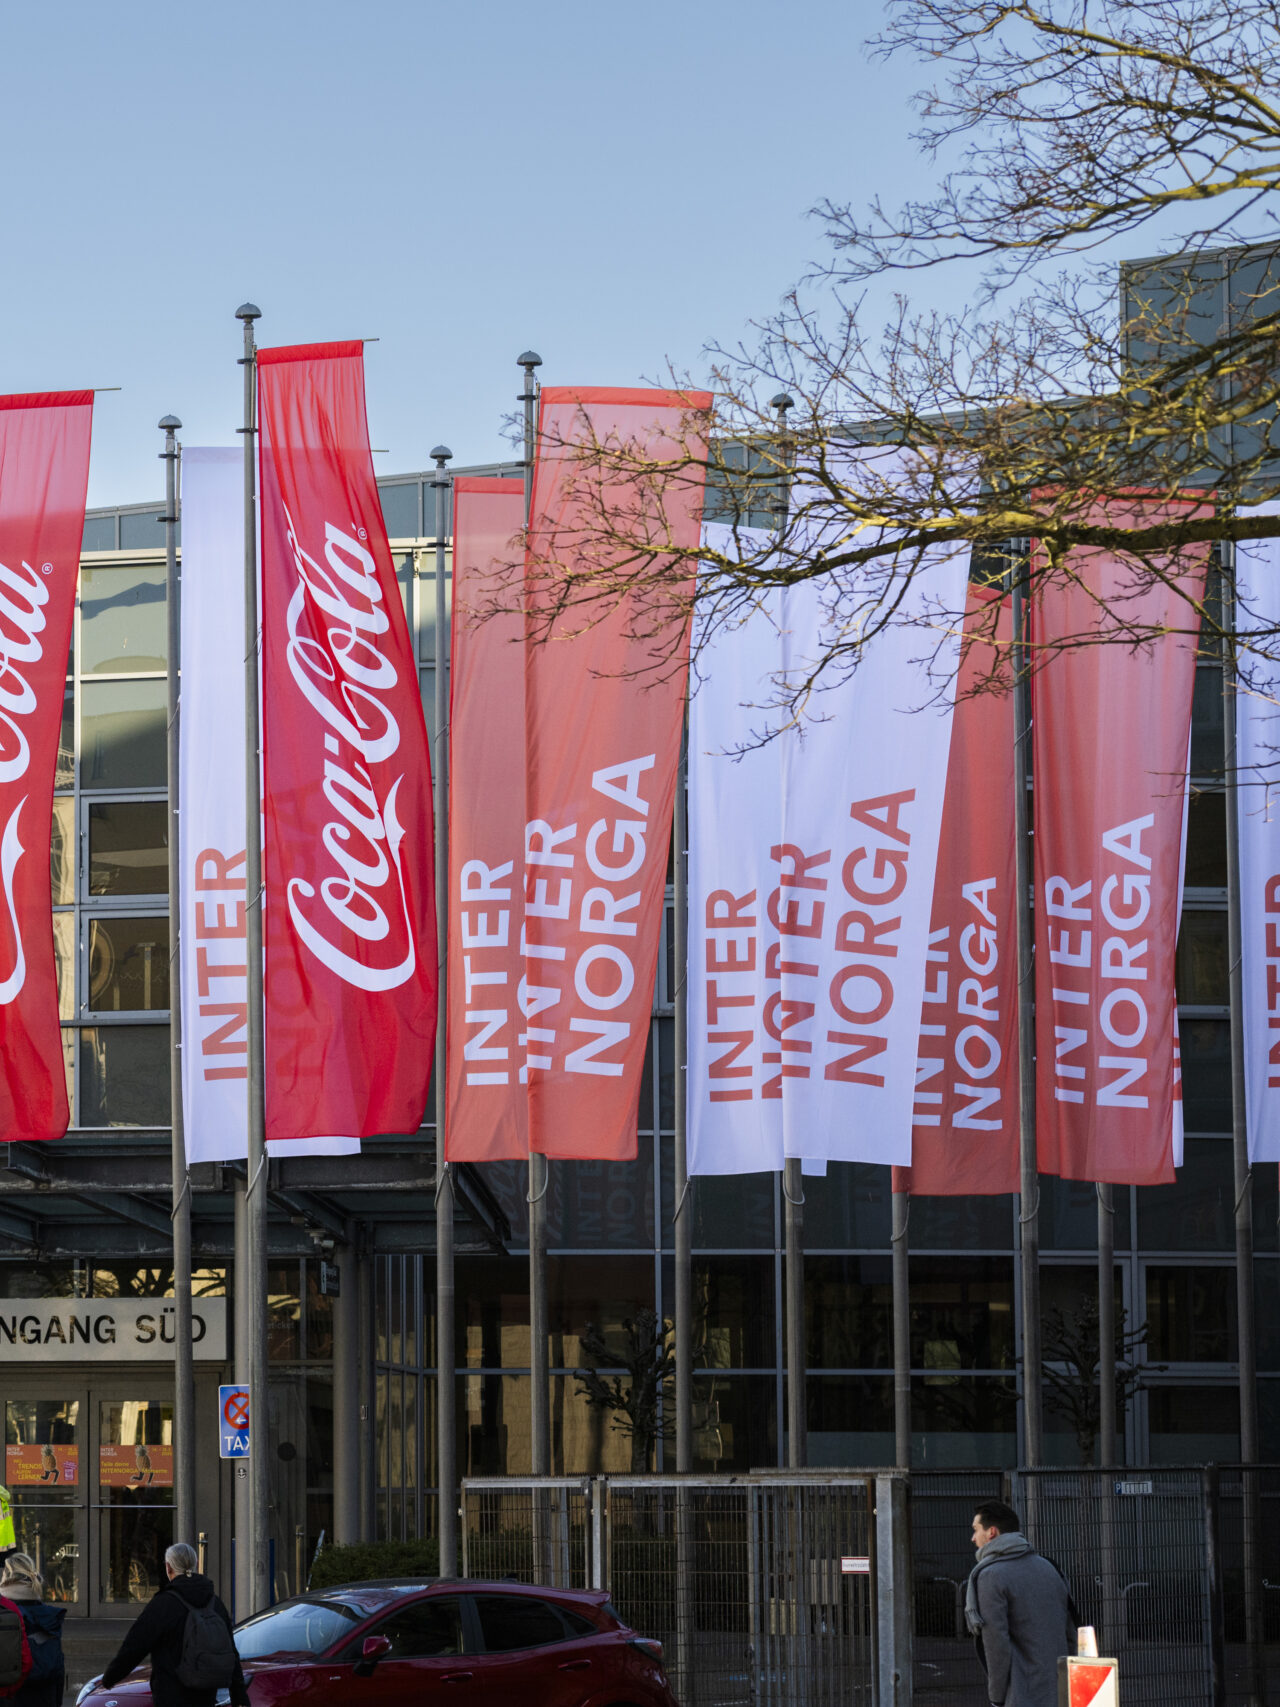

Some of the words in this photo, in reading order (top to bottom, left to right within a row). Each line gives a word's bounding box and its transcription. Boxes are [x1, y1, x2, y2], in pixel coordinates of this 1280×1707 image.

[287, 500, 415, 991] Coca-Cola
[195, 848, 247, 1081] INTER
[460, 859, 514, 1086] INTER
[564, 753, 656, 1076] NORGA
[706, 889, 756, 1102] INTER
[824, 788, 916, 1088] NORGA
[952, 877, 1003, 1131] NORGA
[1044, 875, 1092, 1104] INTER
[1096, 813, 1154, 1109] NORGA
[135, 1308, 206, 1344] SÜD
[224, 1435, 250, 1451] TAX
